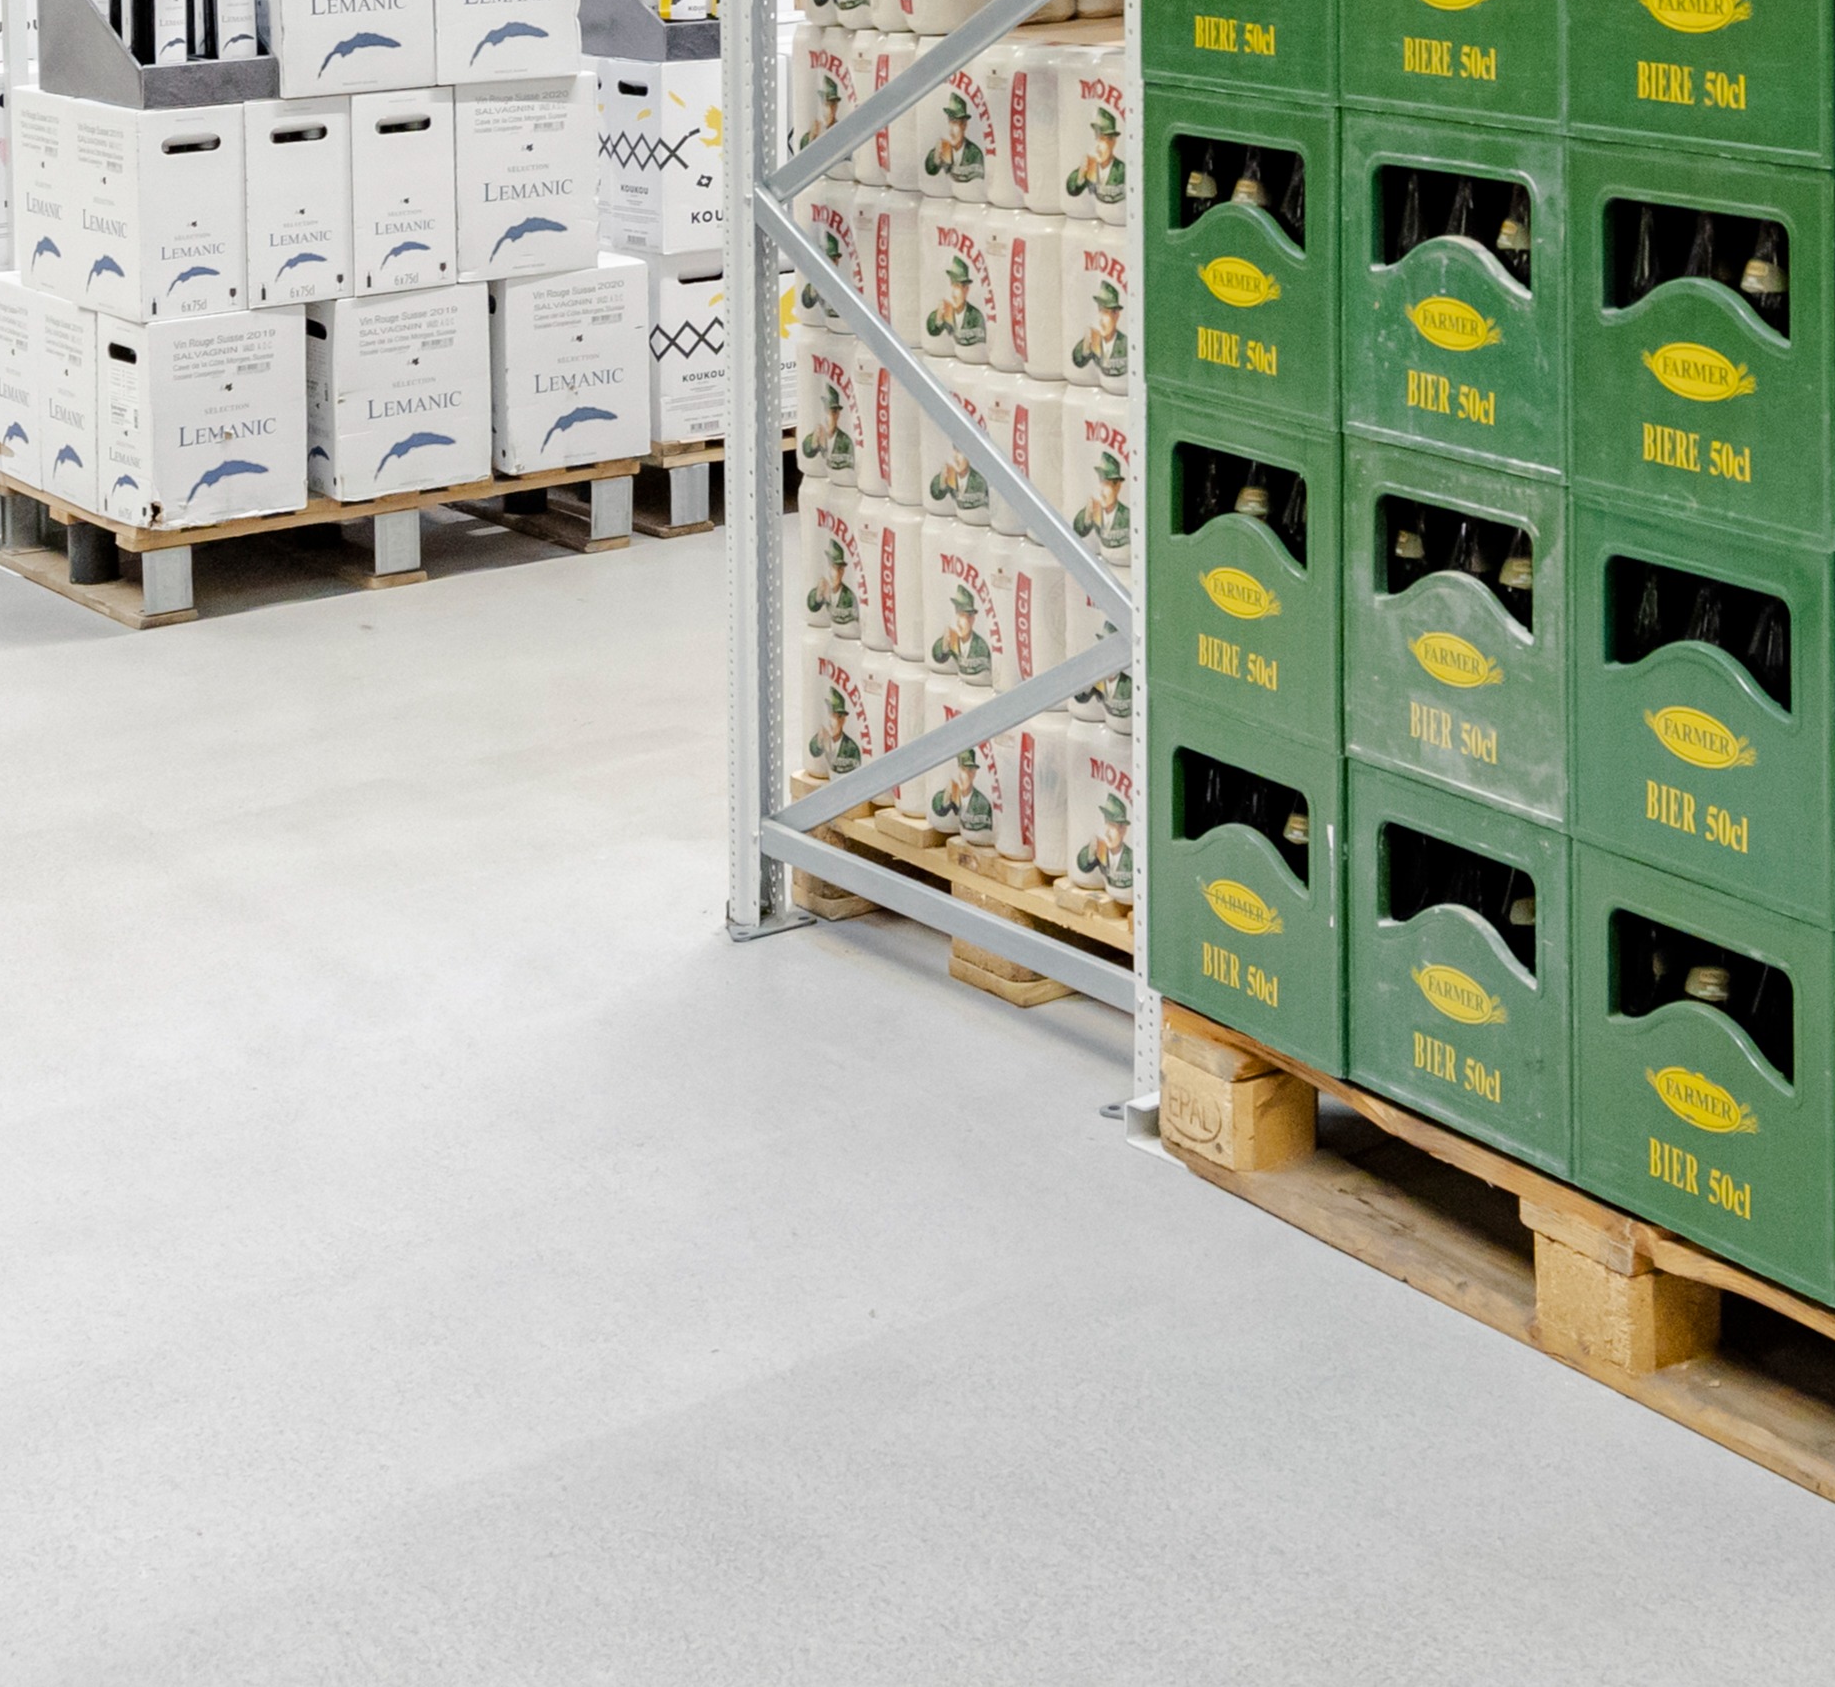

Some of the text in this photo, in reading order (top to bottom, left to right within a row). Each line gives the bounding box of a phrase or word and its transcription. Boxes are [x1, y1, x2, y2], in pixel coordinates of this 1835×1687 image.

[1402, 35, 1498, 81] BIERE 50cl
[483, 178, 574, 204] LEMANIC
[620, 184, 649, 195] KOUKOU
[81, 209, 128, 239] LEMANIC
[160, 243, 226, 261] LEMANIC
[936, 225, 997, 325] MORETTI
[1209, 264, 1265, 299] FARMER
[173, 328, 276, 350] Vin Rouge Suisse 2019
[1195, 325, 1279, 377] BIERE 50cl
[534, 367, 624, 395] LEMANIC
[682, 369, 725, 383] KOUKOU
[367, 391, 463, 421] LEMANIC
[812, 353, 865, 449] MORETTI
[178, 417, 277, 448] LEMANIC
[816, 508, 870, 608] MORETTI
[940, 552, 1004, 656] MORETTI
[817, 657, 872, 757] MORETTI
[1660, 715, 1733, 760] FARMER
[1644, 778, 1750, 855] BIER 50cl
[1425, 972, 1486, 1016] FARMER
[1412, 1031, 1503, 1105] BIER 50cl
